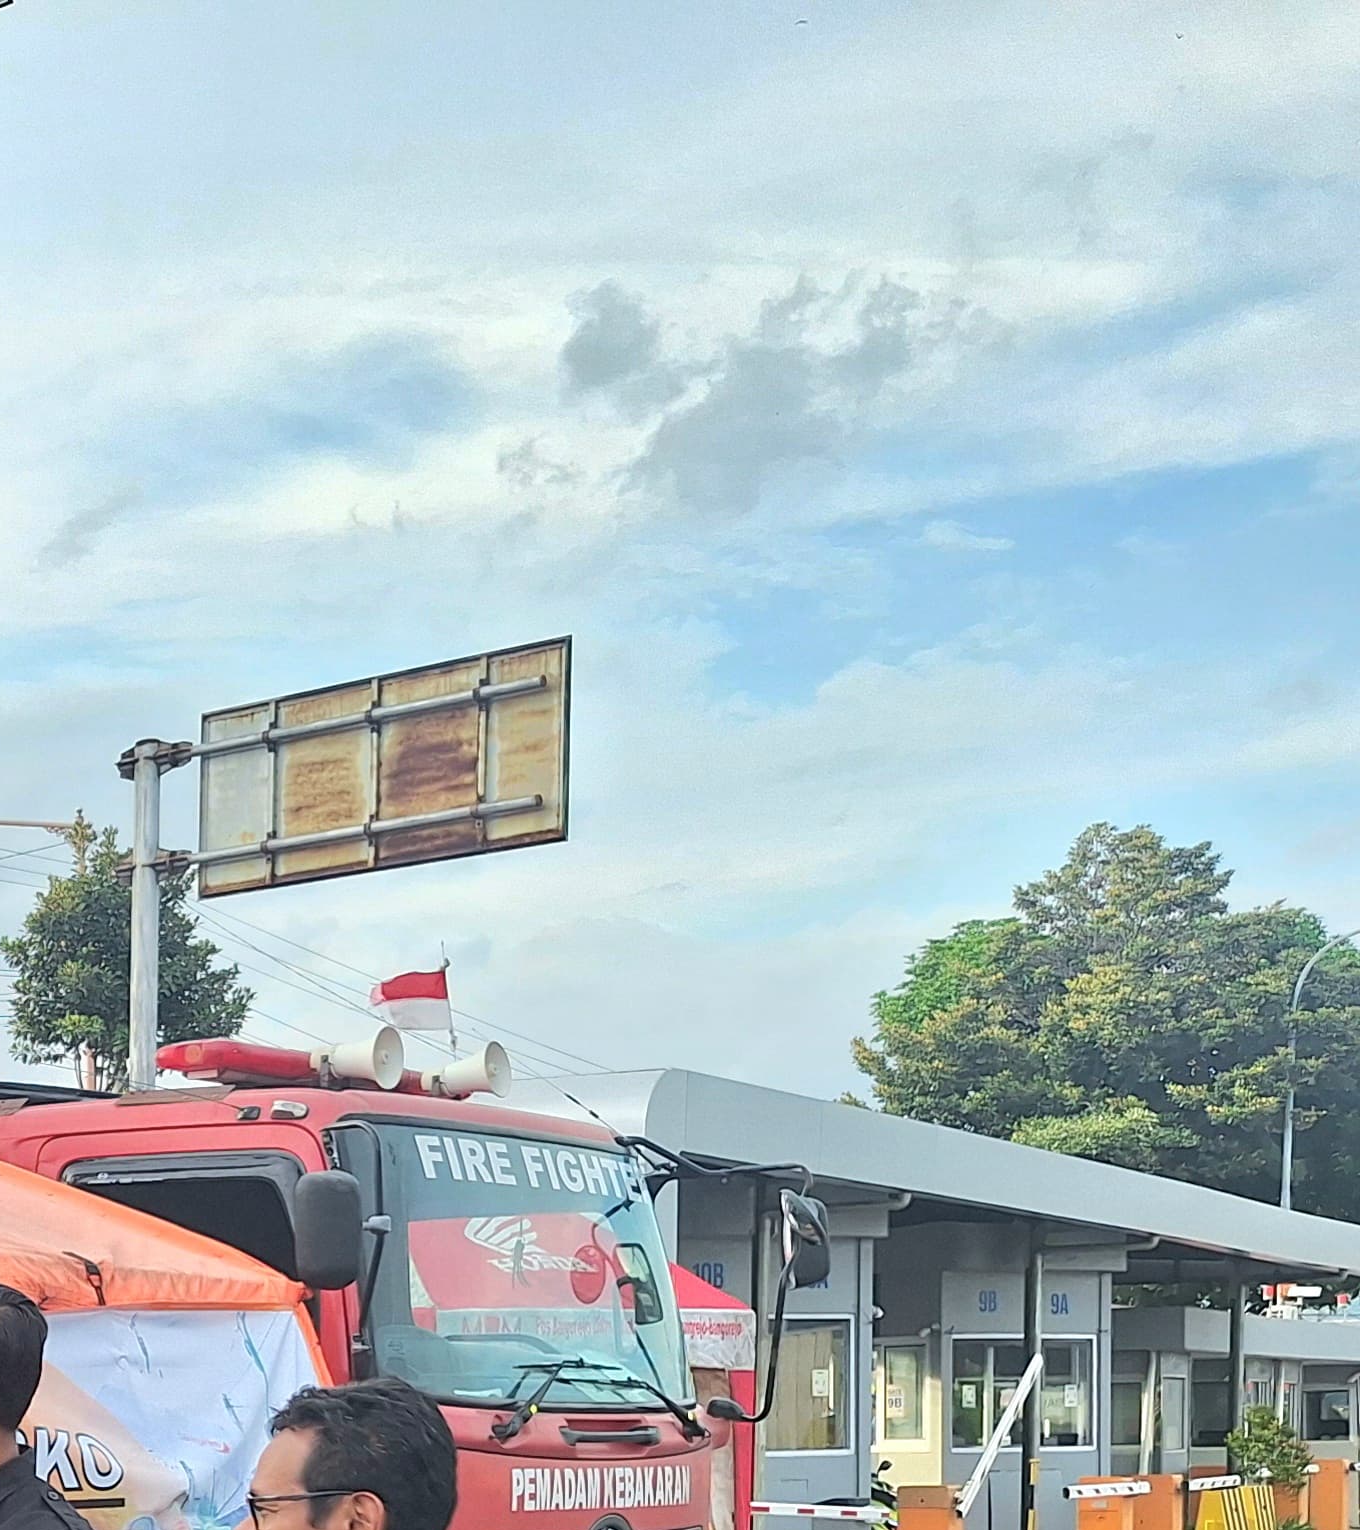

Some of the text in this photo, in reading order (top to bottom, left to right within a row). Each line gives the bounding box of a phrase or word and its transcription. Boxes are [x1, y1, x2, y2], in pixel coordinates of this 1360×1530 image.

[414, 1135, 516, 1186] FIRE
[978, 1290, 997, 1313] 9B
[1050, 1293, 1069, 1315] 9A
[18, 1426, 125, 1493] KO
[511, 1465, 690, 1511] PEMADAM KEBAKARAN
